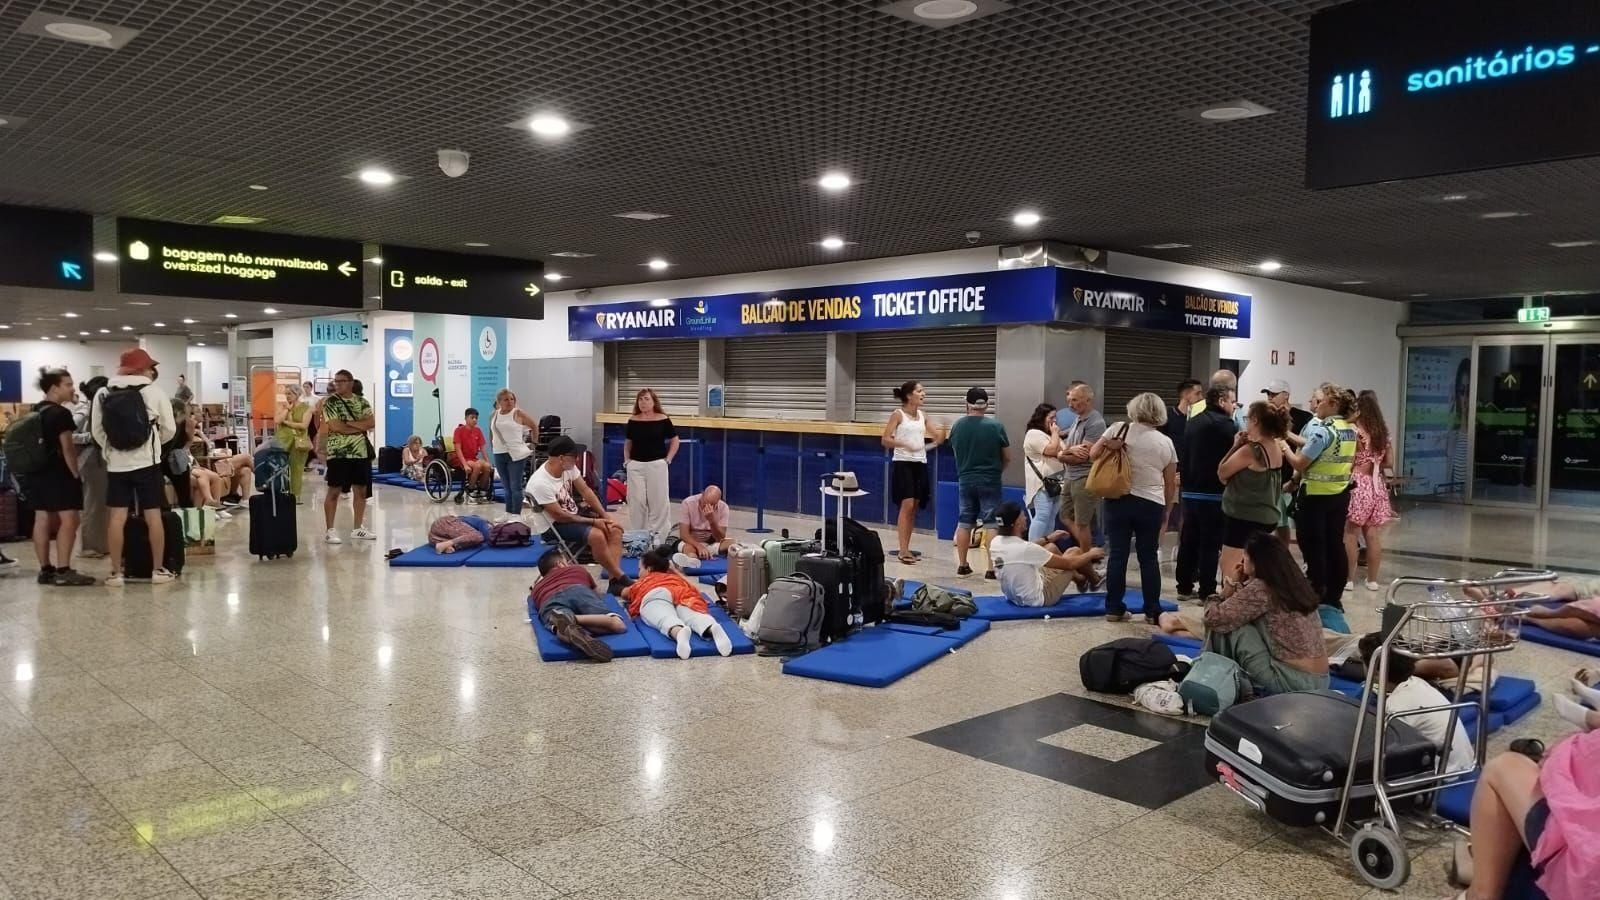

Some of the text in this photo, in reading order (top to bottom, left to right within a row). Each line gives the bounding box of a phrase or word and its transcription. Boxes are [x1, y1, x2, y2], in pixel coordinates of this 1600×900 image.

[1407, 45, 1575, 92] sanitários
[163, 245, 328, 271] bagagem não normalizada
[163, 260, 277, 280] oversized baggage
[450, 278, 468, 288] exit
[741, 286, 986, 325] BALCÃO DE VENDAS TICKET OFFICE
[1083, 290, 1145, 313] RYANAIR
[1184, 294, 1239, 315] BALCÃO DE VENDAS
[606, 309, 675, 329] RYANAIR
[1184, 313, 1238, 330] TICKET OFFICE
